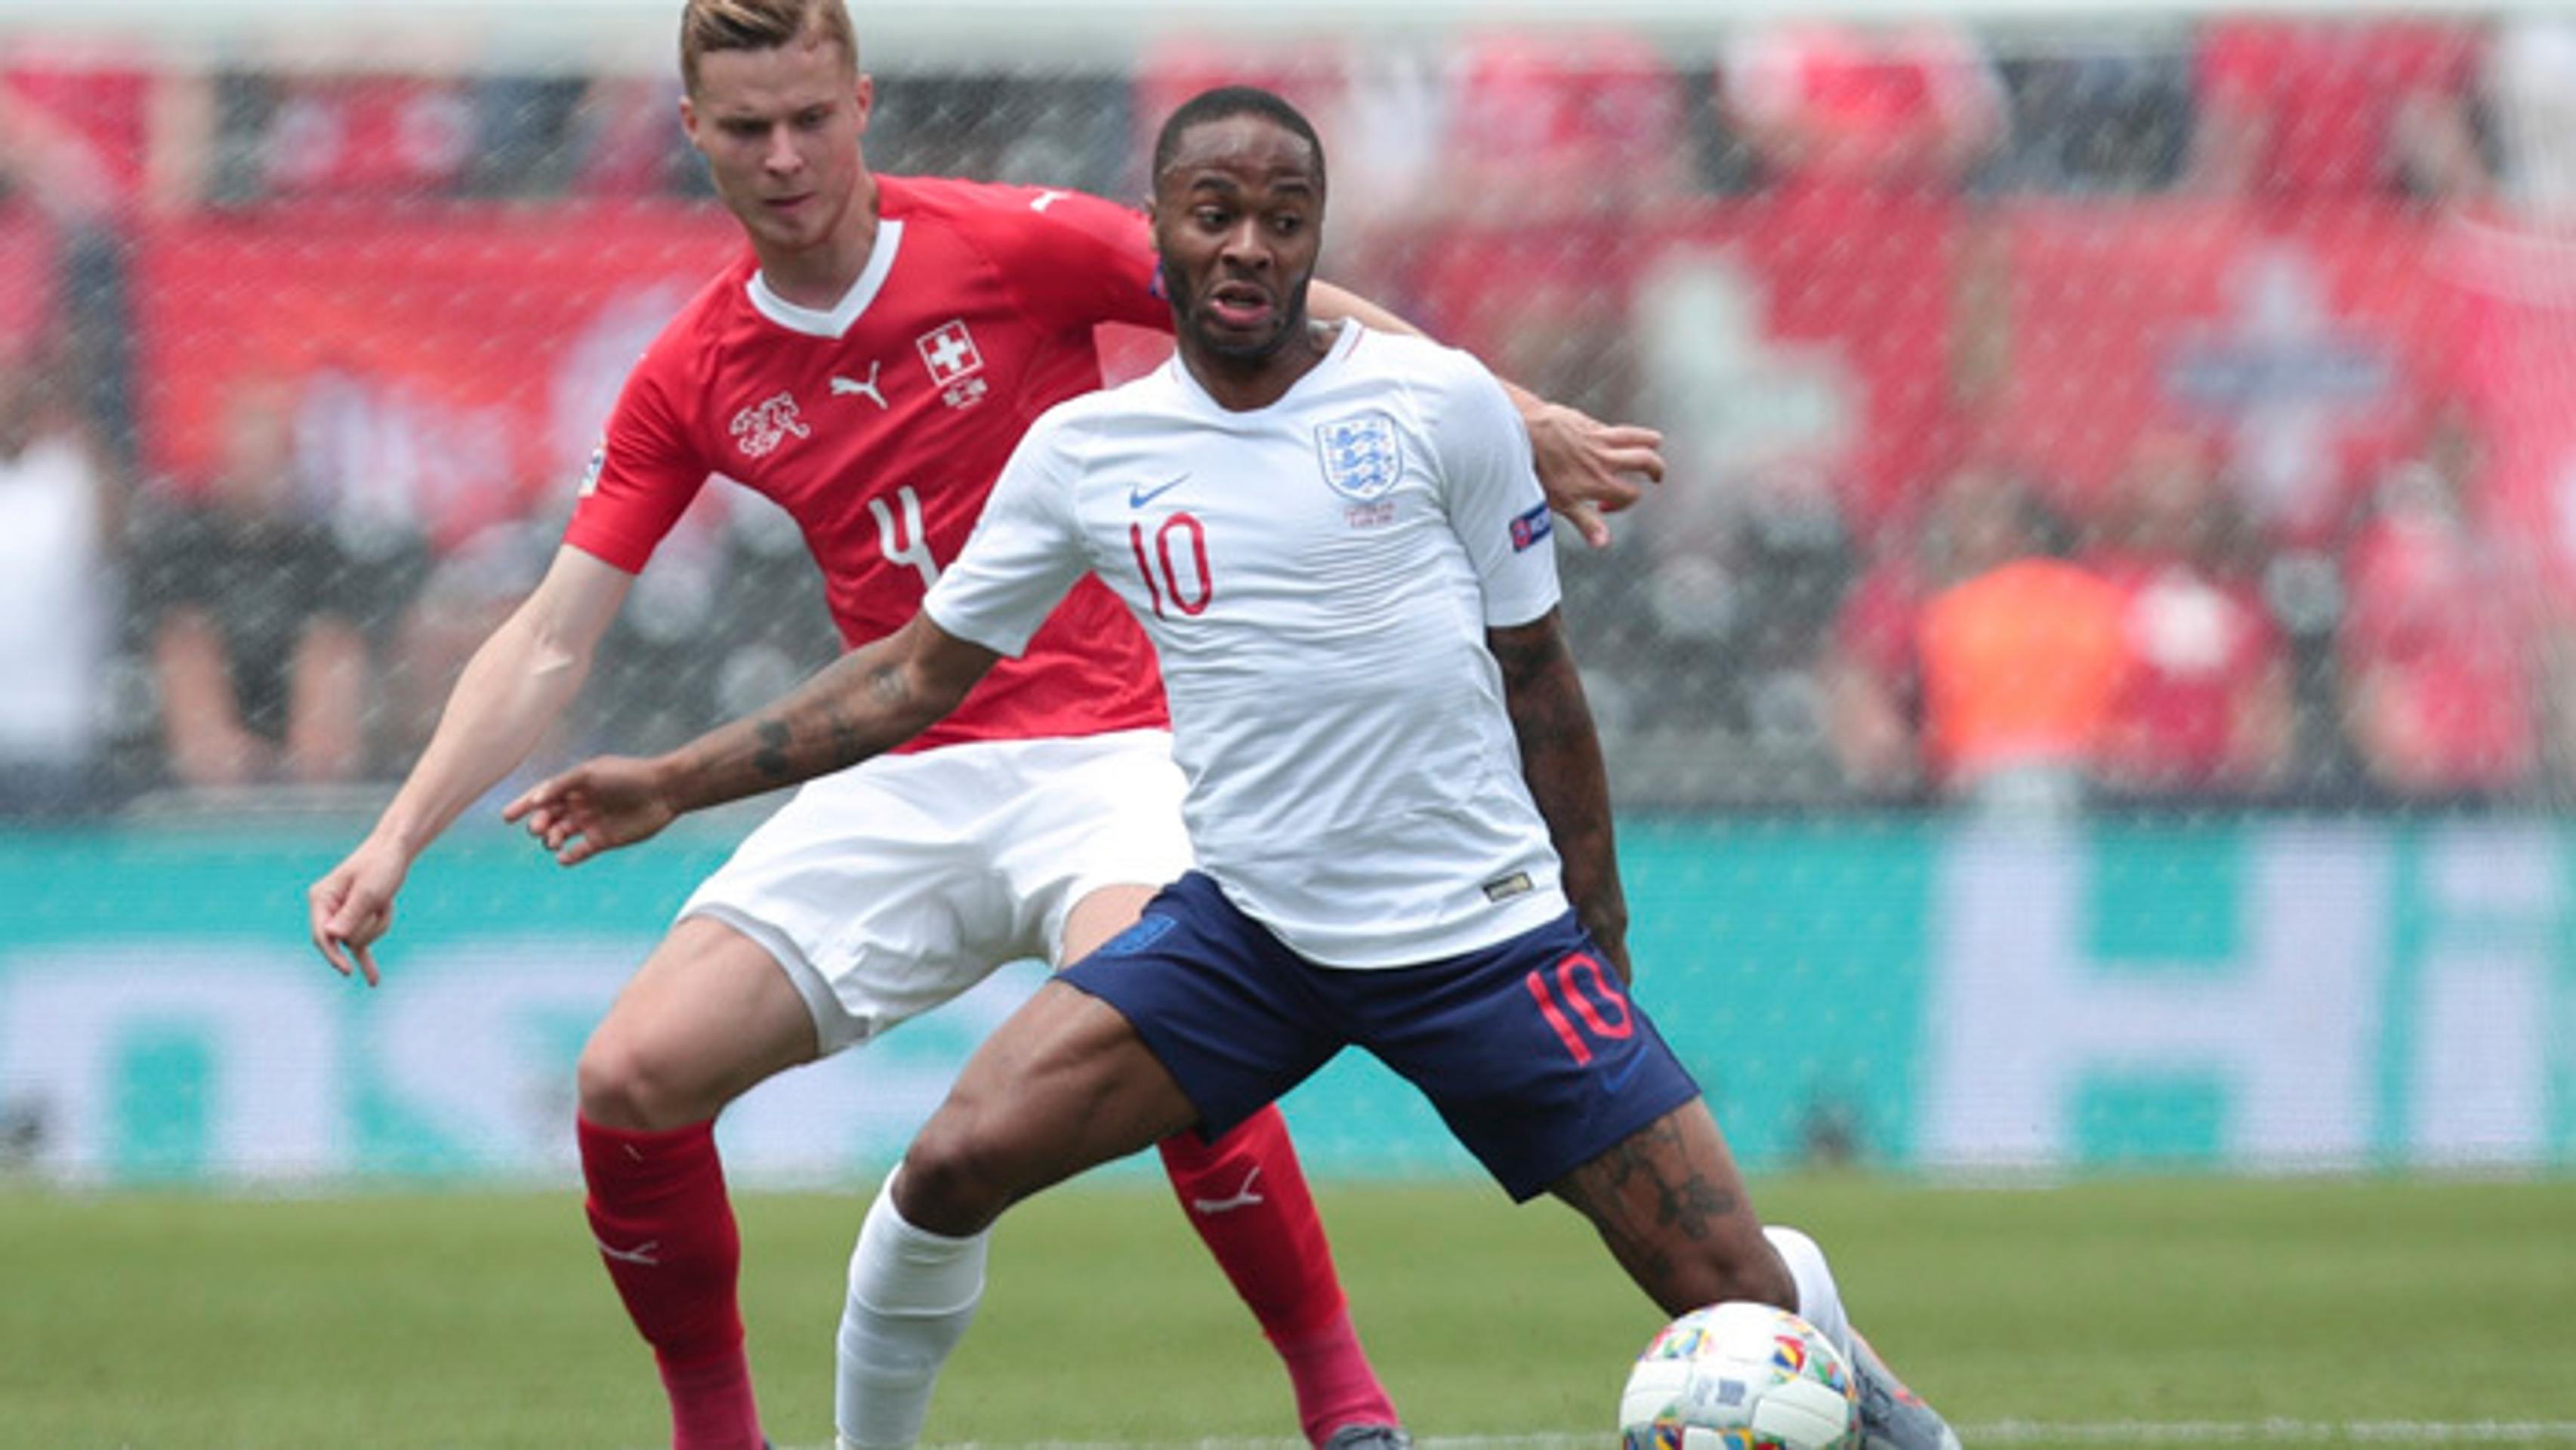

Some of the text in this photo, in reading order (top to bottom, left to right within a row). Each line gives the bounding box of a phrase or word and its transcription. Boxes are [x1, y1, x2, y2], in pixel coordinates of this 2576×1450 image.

[868, 485, 941, 589] 4
[1130, 511, 1212, 622] 10
[1526, 952, 1633, 1068] 10
[1922, 822, 2560, 1175] Hi
